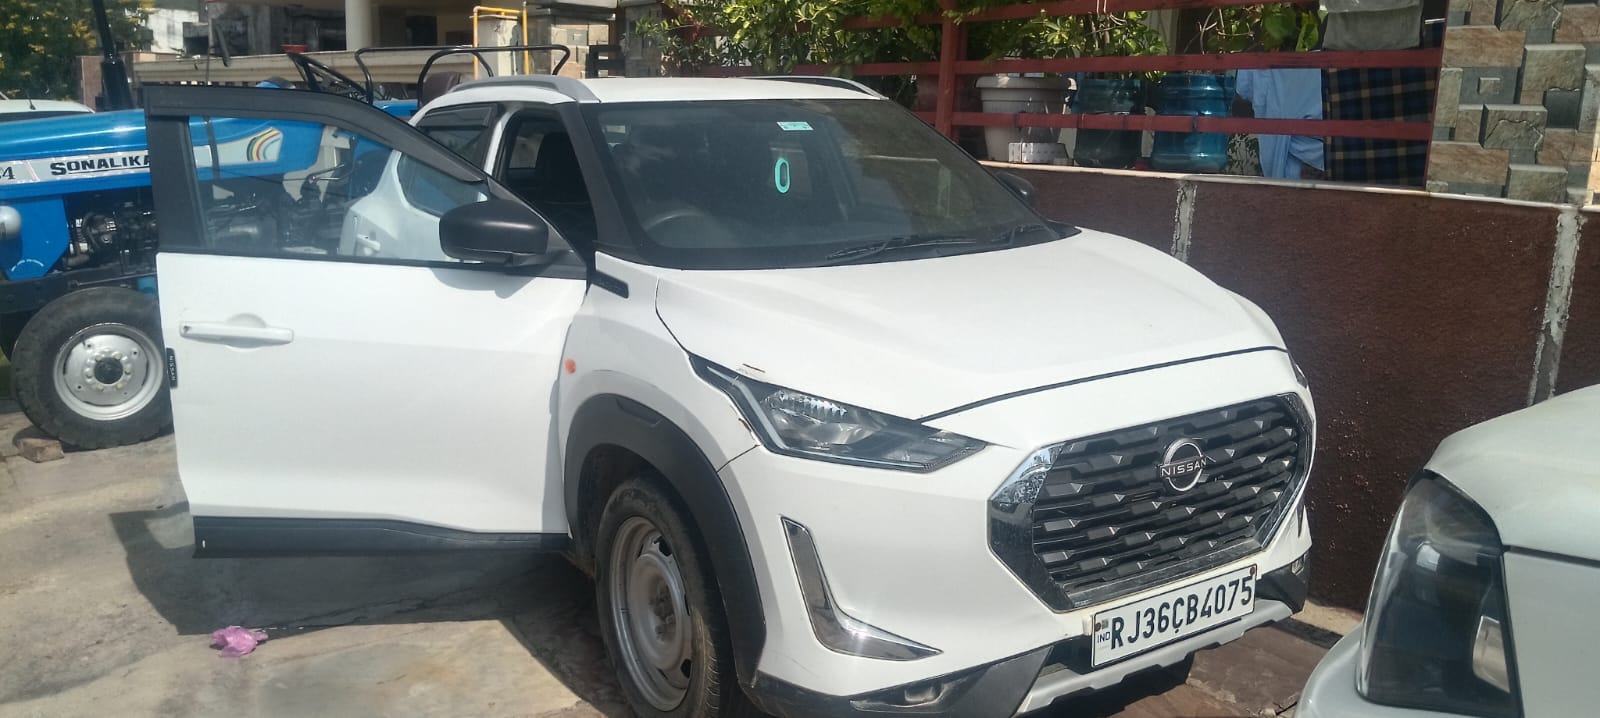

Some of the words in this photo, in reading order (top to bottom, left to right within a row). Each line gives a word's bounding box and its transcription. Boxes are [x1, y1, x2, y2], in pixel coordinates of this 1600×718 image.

[0, 166, 16, 180] 4
[1161, 457, 1207, 477] NISSAN
[1111, 575, 1253, 650] RJ36CB4075
[1097, 631, 1111, 644] IND
